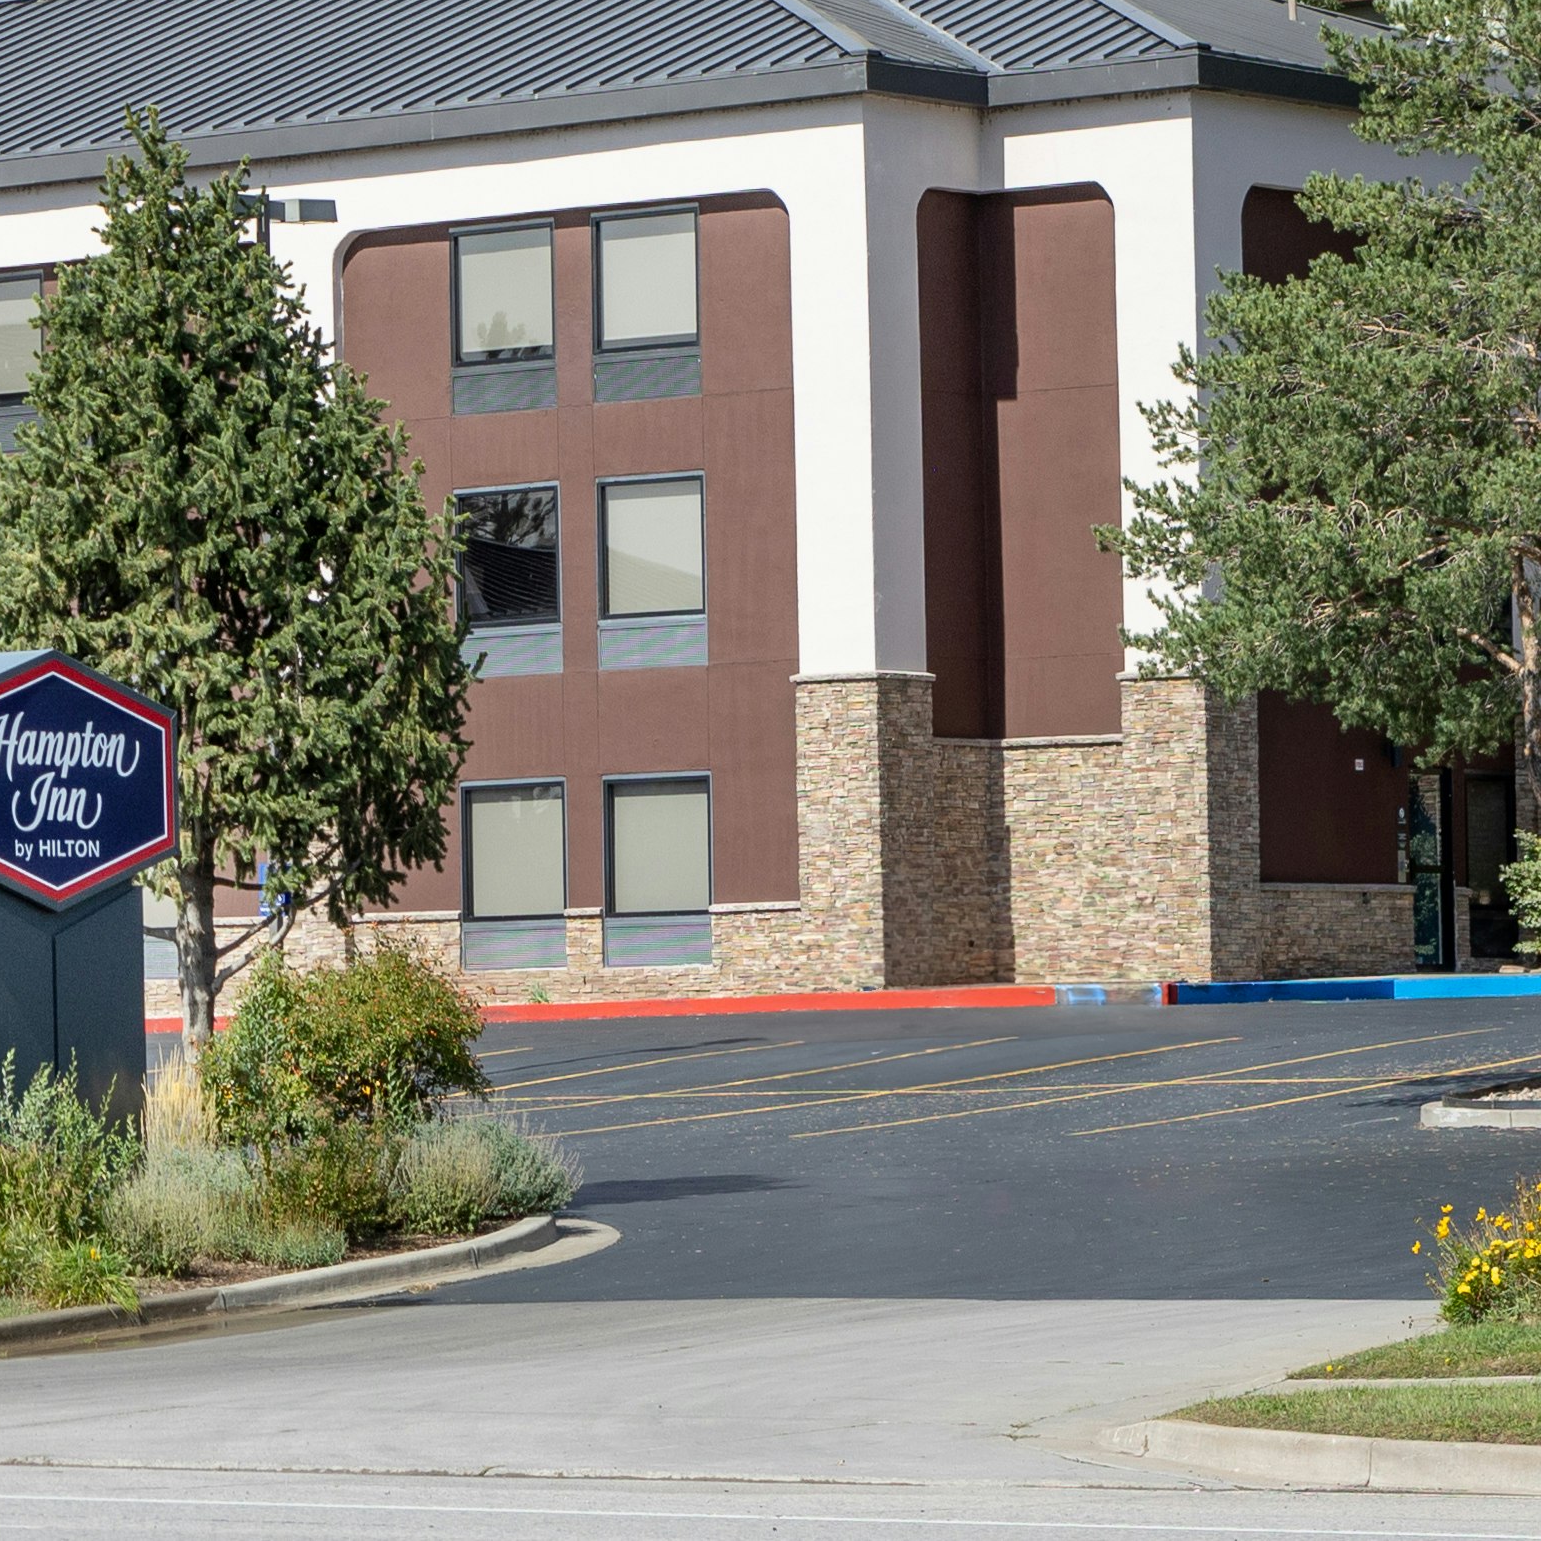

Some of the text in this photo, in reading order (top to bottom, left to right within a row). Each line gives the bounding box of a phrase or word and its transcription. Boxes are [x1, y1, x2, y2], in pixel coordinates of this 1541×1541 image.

[12, 771, 102, 832] Inn
[14, 839, 100, 862] by HILTON
